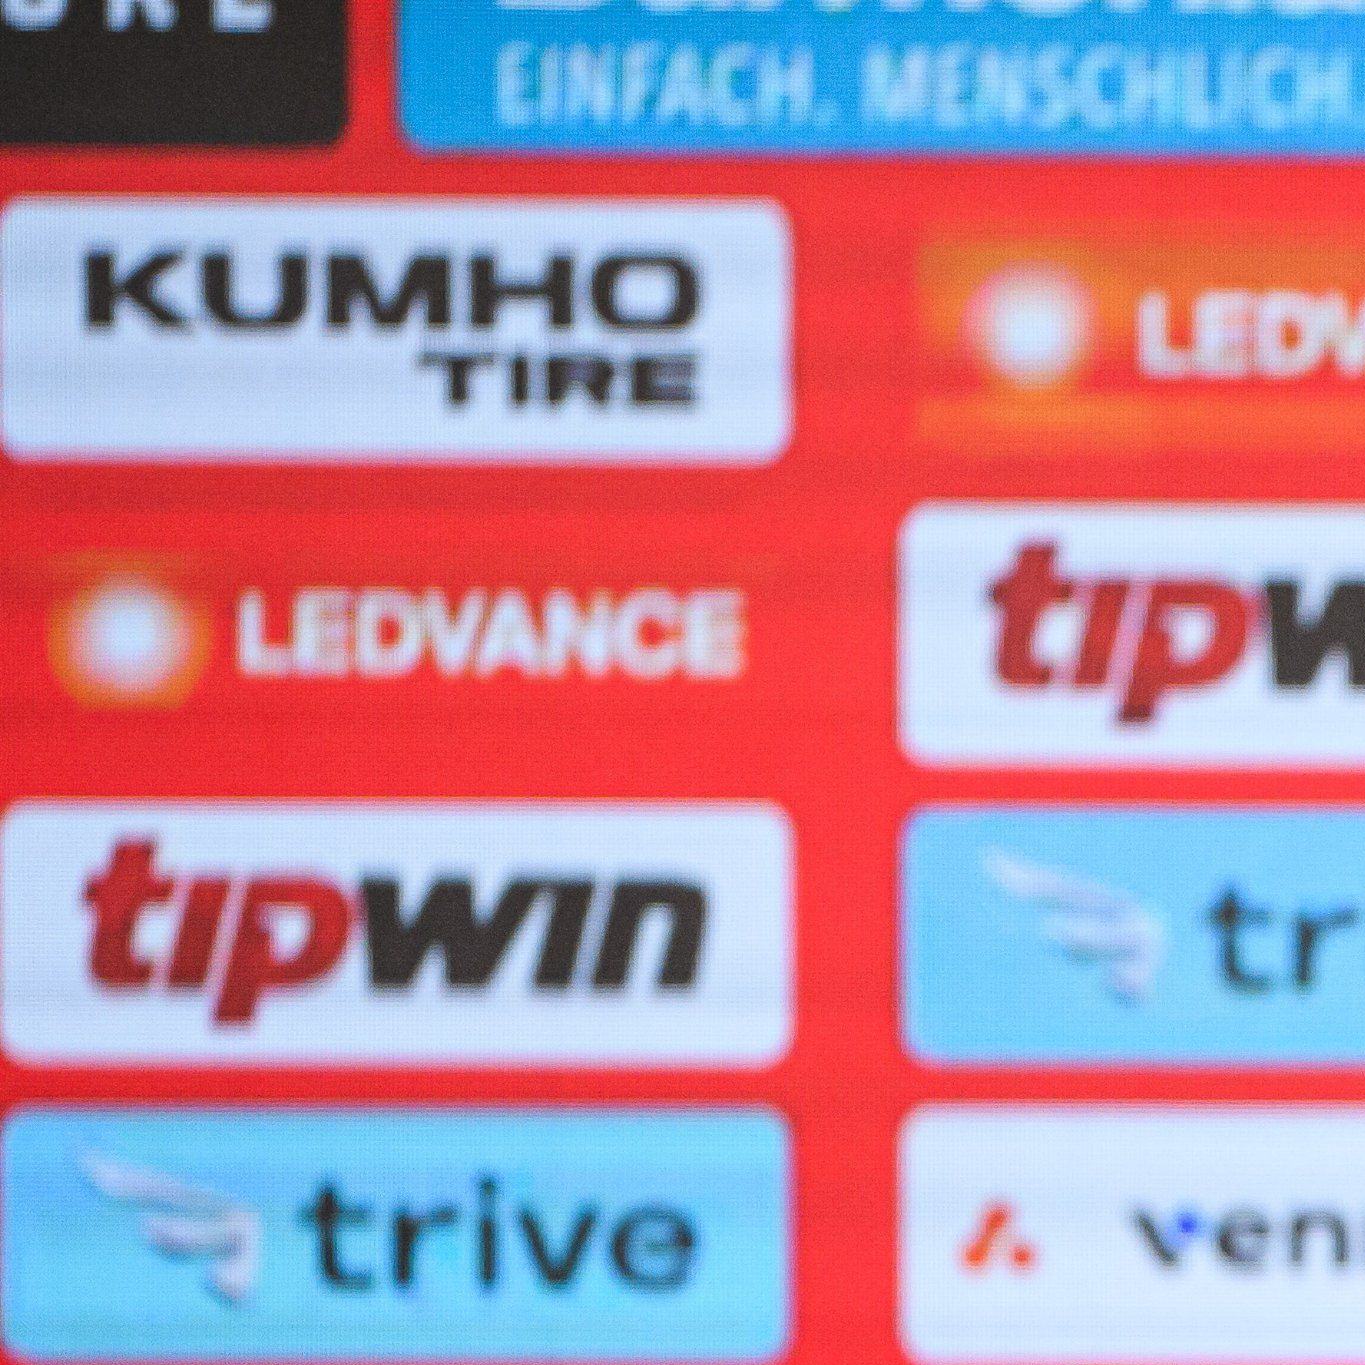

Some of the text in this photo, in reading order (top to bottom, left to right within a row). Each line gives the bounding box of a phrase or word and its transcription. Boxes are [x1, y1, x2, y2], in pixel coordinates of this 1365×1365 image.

[83, 246, 701, 331] KUMHO
[422, 350, 702, 409] TIRE
[238, 585, 745, 678] LEDVANCE
[83, 832, 706, 1027] tipwin
[302, 1171, 700, 1291] trive
